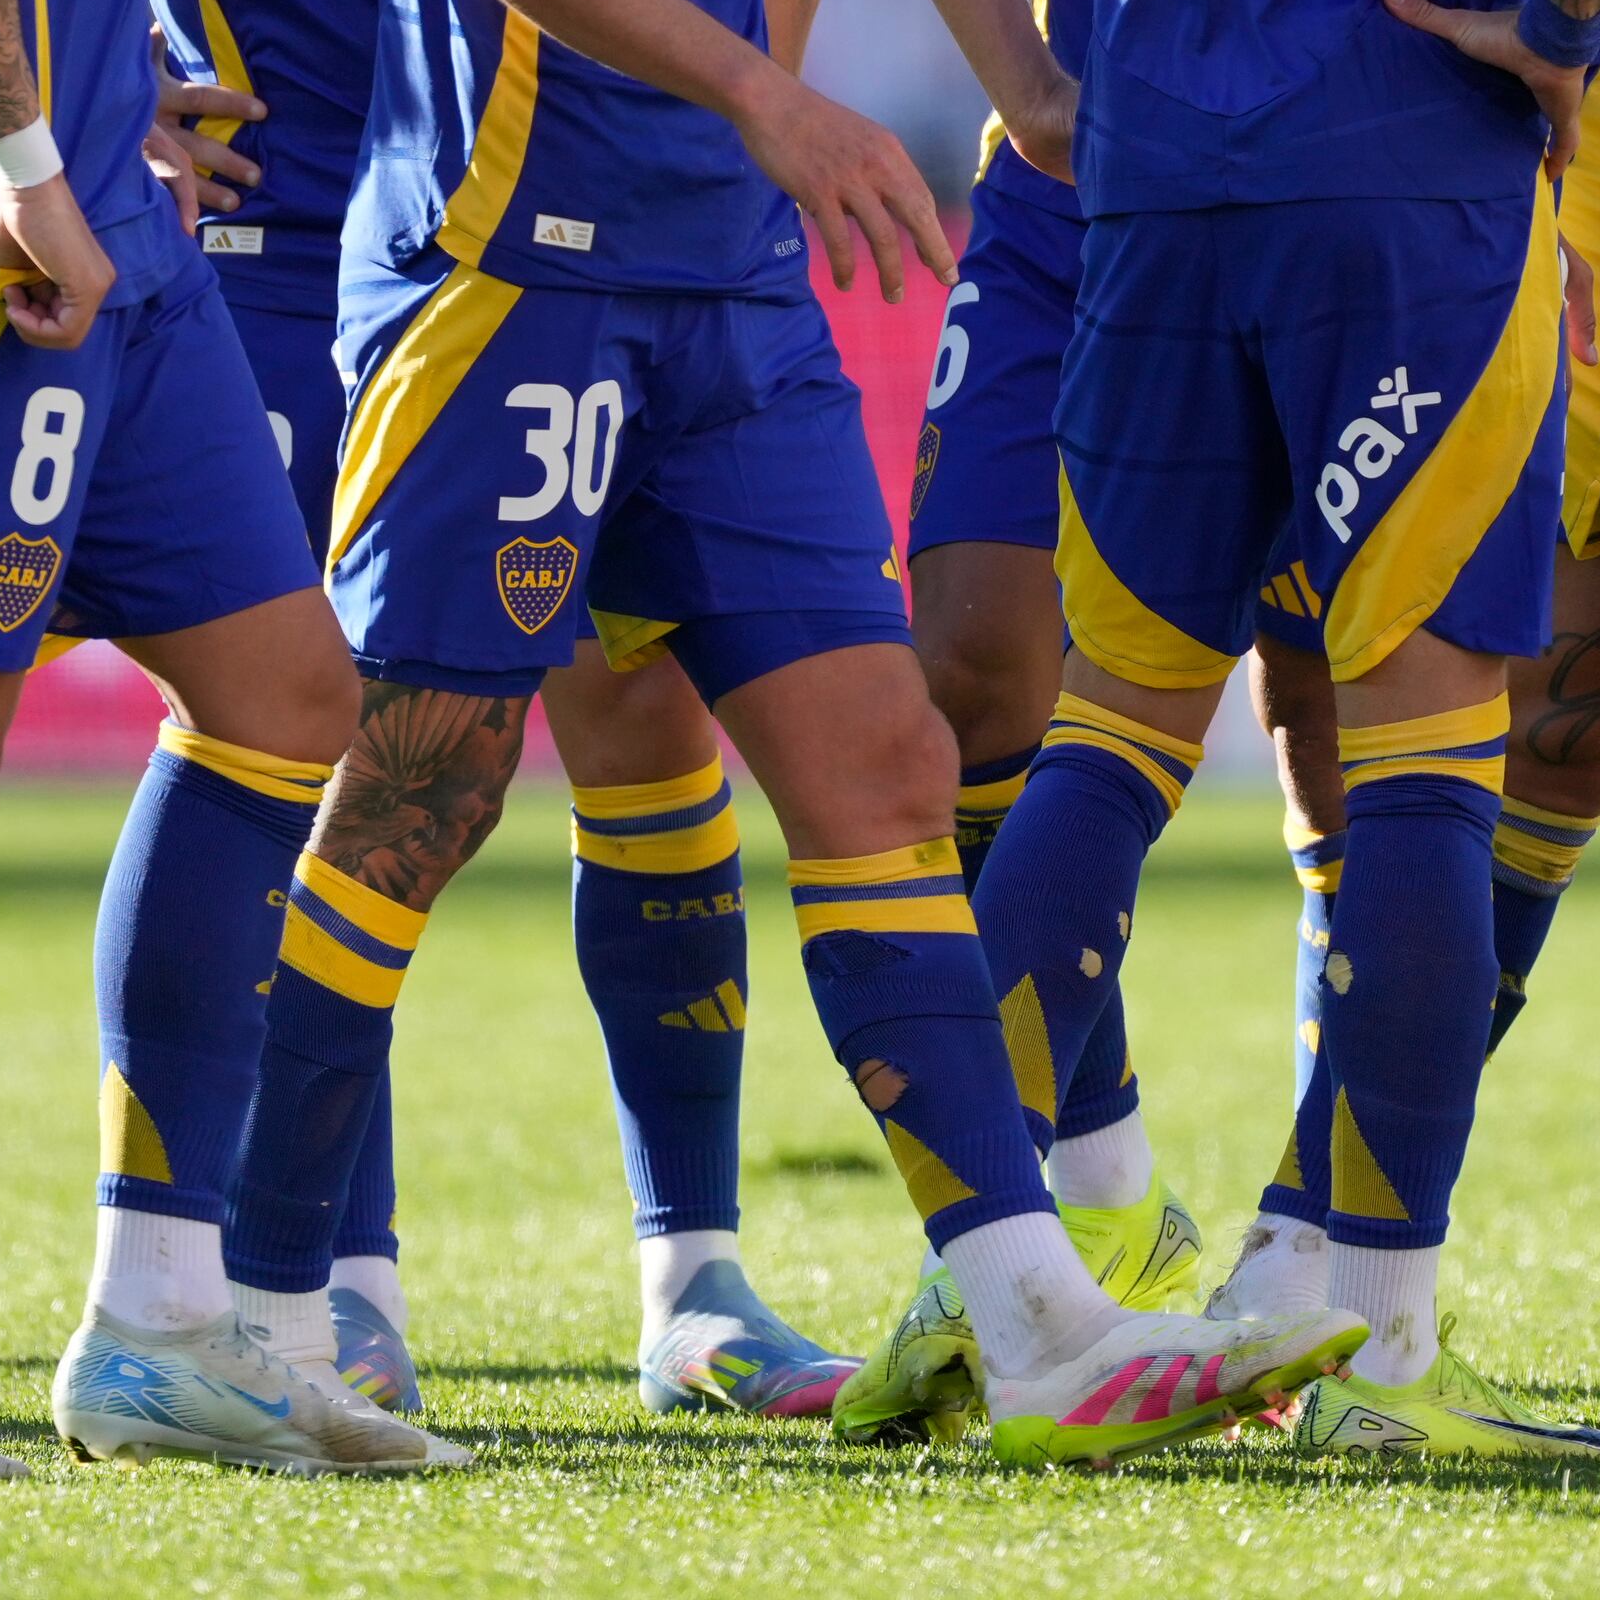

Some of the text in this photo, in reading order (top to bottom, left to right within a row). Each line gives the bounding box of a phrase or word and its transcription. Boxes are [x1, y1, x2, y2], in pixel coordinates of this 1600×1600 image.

[10, 386, 86, 526] 8
[498, 380, 624, 522] 30
[1314, 366, 1442, 544] pax
[505, 569, 566, 589] CABJ
[642, 885, 744, 922] CABJ
